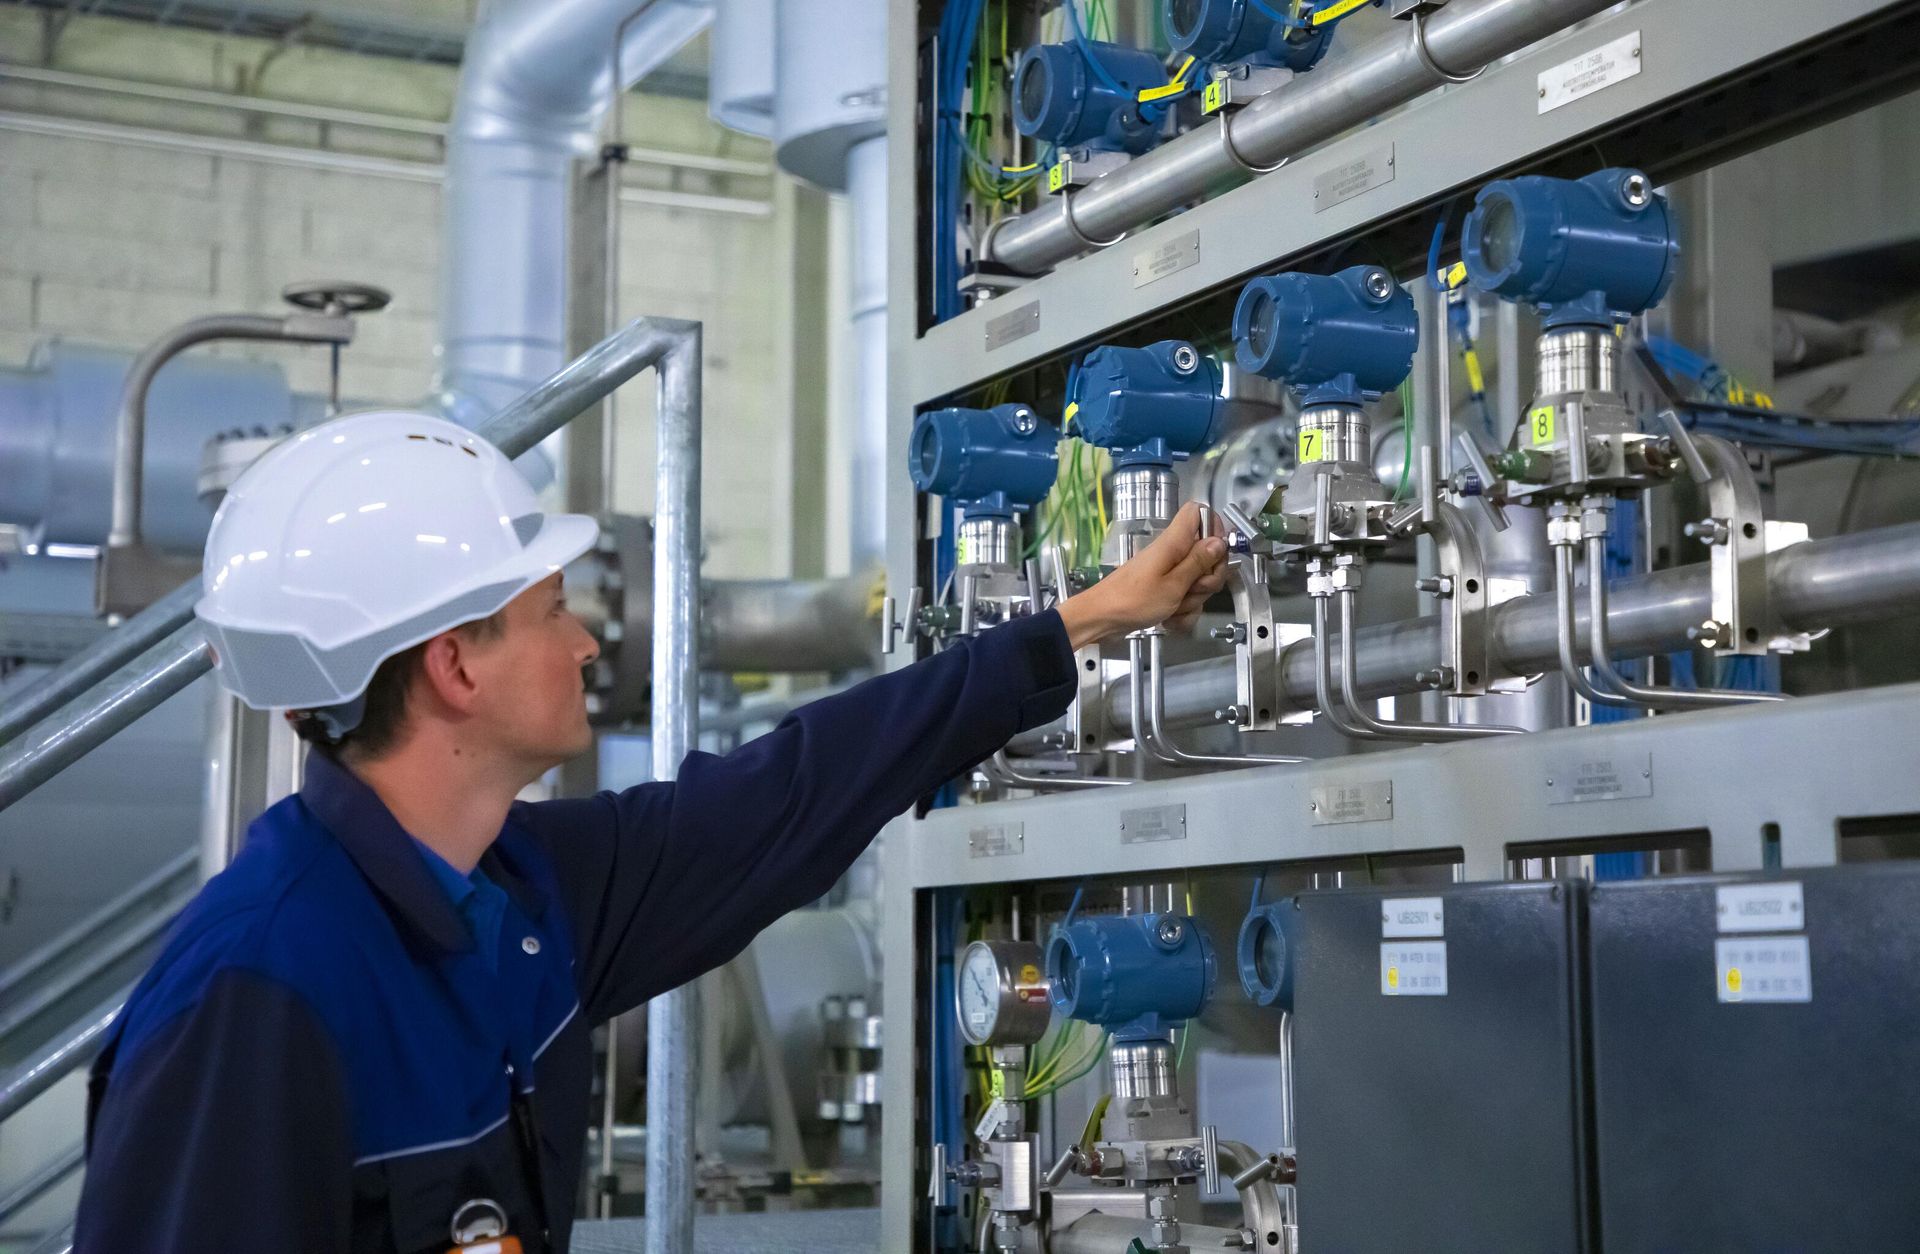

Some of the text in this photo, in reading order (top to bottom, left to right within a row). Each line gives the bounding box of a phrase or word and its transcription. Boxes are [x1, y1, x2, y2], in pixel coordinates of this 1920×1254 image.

[1208, 86, 1216, 105] 4
[1052, 168, 1058, 186] 3
[1538, 413, 1548, 438] 8
[1303, 434, 1314, 456] 7
